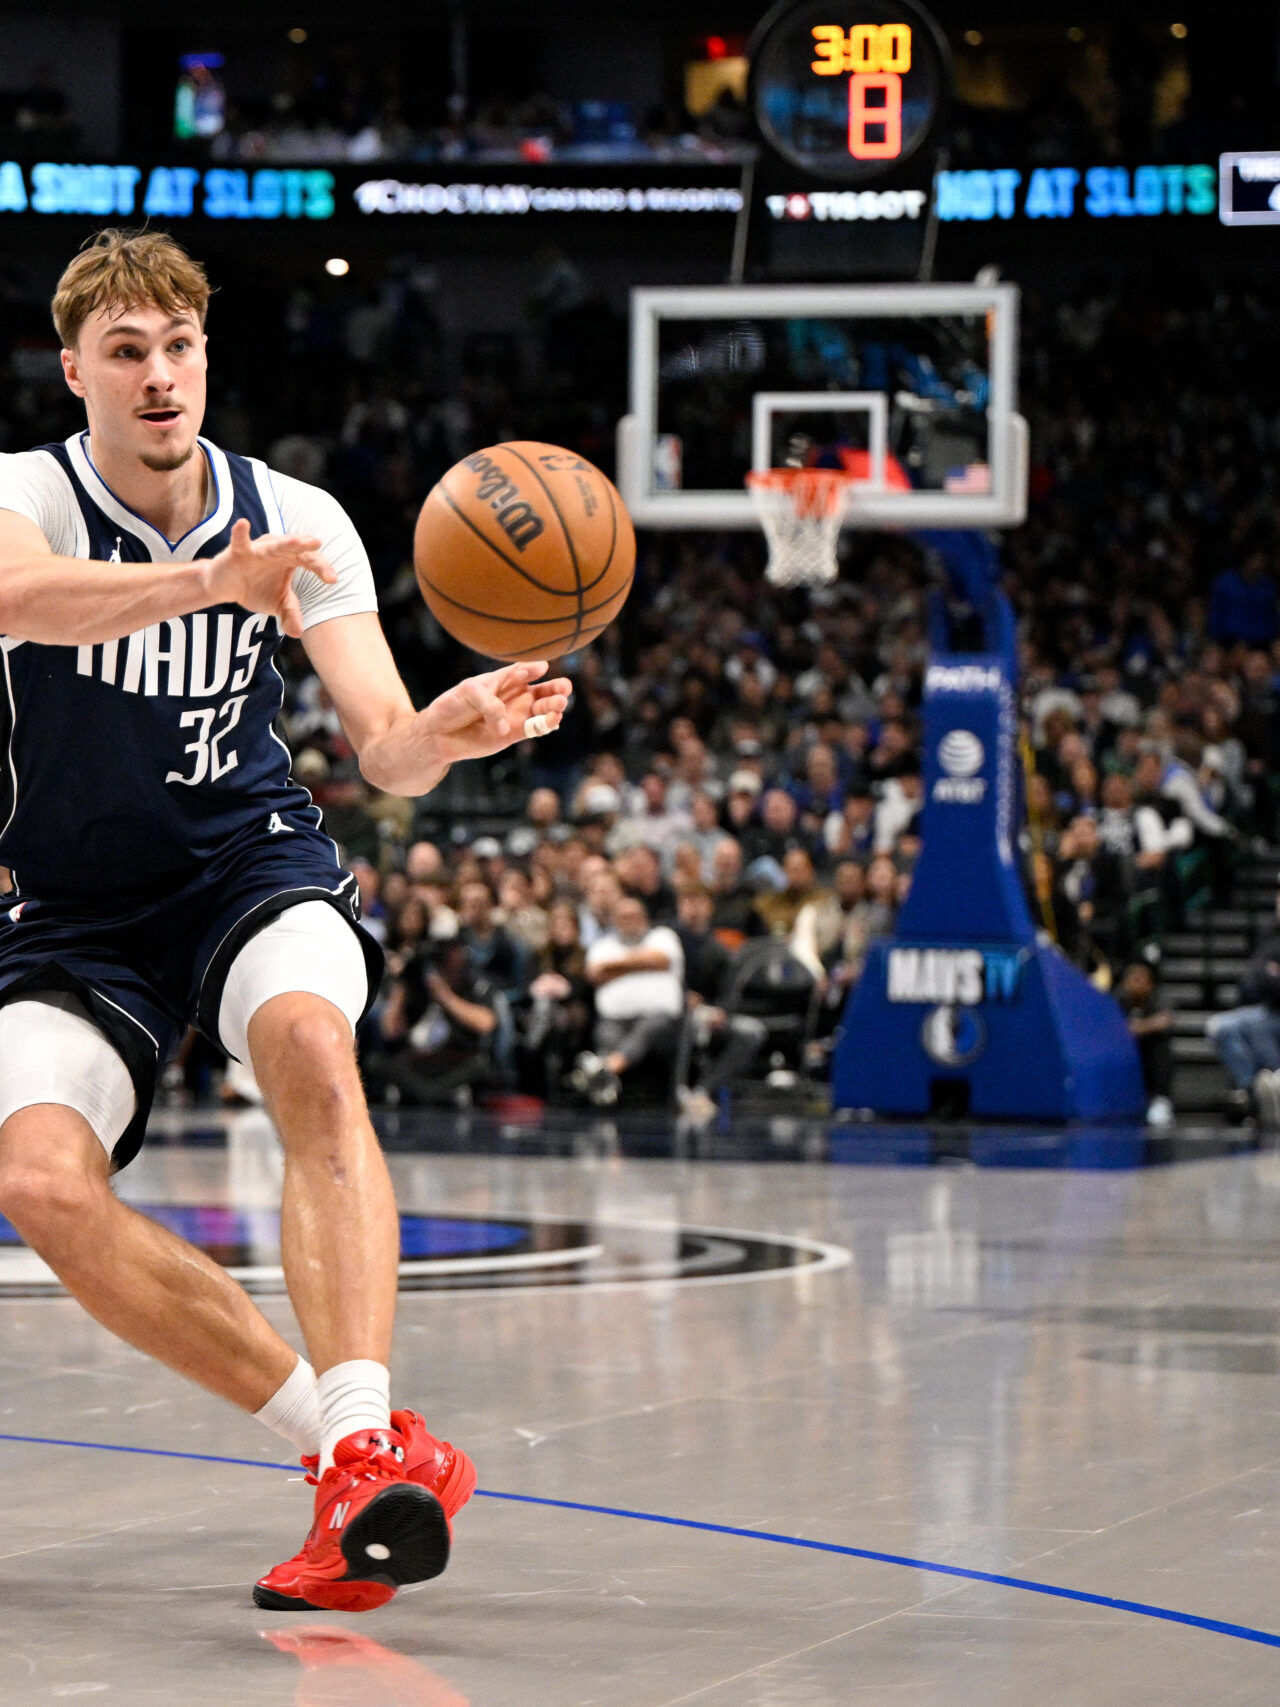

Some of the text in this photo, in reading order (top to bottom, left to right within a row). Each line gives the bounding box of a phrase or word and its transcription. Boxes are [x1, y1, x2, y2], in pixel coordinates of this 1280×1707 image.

[811, 23, 912, 75] 3:00
[848, 72, 902, 160] 8
[30, 162, 142, 216] SHOT
[143, 166, 200, 217] AT
[202, 168, 336, 219] SLOTS
[808, 190, 926, 220] TISSOT
[1024, 167, 1080, 219] AT
[1084, 164, 1216, 217] SLOTS
[165, 694, 249, 786] 32
